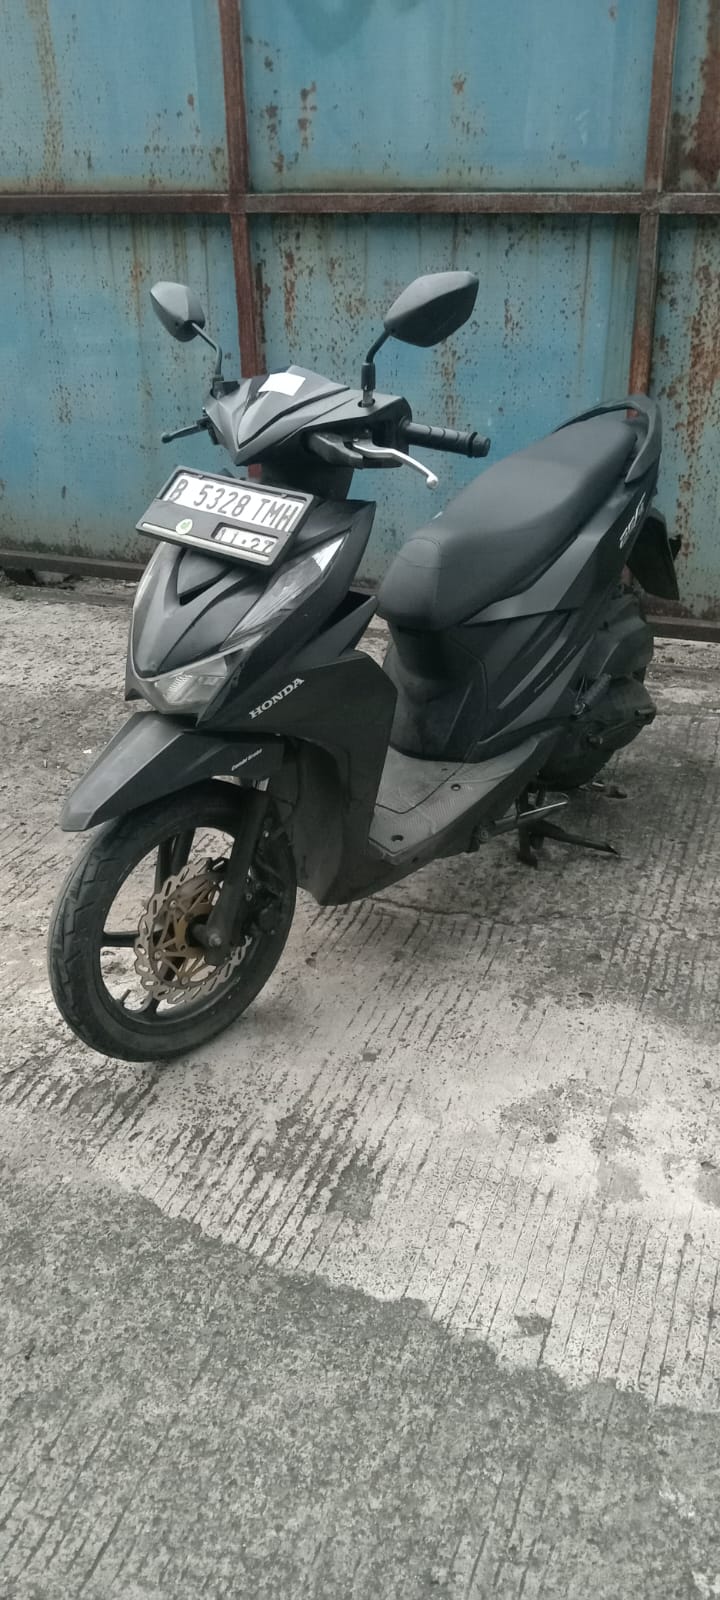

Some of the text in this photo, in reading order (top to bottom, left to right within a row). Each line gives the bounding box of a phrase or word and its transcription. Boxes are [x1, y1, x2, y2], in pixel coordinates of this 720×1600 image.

[169, 479, 299, 532] B 5328 TMH
[248, 678, 304, 719] HONDA
